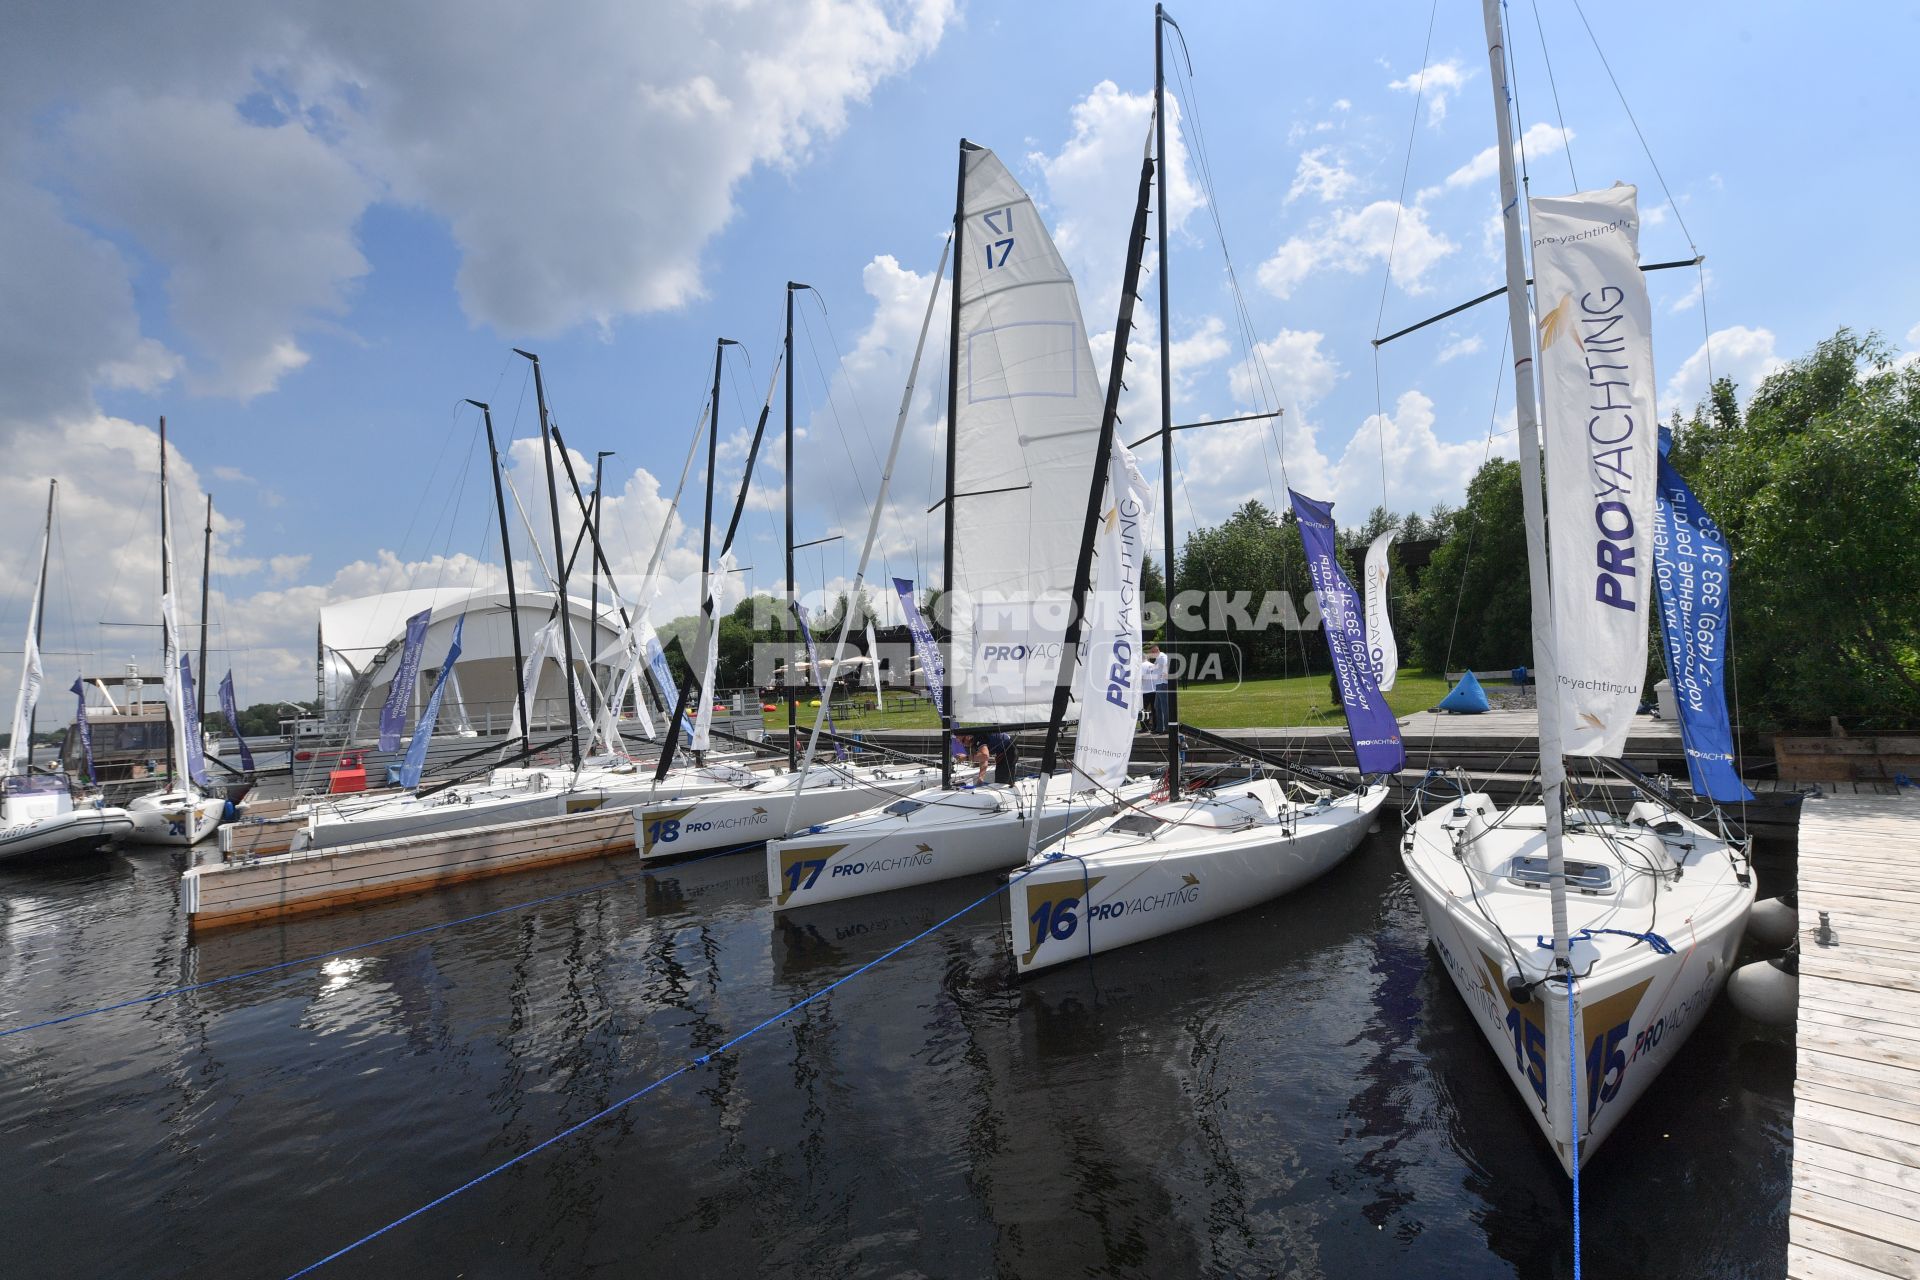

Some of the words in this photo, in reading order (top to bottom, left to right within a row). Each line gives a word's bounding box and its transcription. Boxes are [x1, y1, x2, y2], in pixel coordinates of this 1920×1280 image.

[986, 237, 1015, 270] 17
[1580, 285, 1637, 612] PROYACHTING
[1669, 488, 1698, 557] регаты
[1319, 554, 1341, 604] регаты
[1701, 545, 1723, 567] 31
[1106, 498, 1141, 710] PROYACHTING
[1341, 593, 1355, 608] 31
[1702, 570, 1723, 609] 393
[1345, 611, 1361, 637] 393
[1678, 561, 1704, 712] корпоративные
[1697, 612, 1721, 662] (499)
[1338, 657, 1357, 707] Прокат
[1557, 674, 1638, 696] ro-yachting.ru
[1699, 663, 1713, 688] +7
[647, 820, 681, 843] 18
[685, 813, 769, 834] PROYACHTING
[784, 858, 827, 892] 17
[832, 853, 933, 878] PROYACHTING
[1030, 897, 1081, 945] 16
[1088, 886, 1200, 922] PROYACHTING
[1436, 935, 1503, 1030] PROYACHTING
[1505, 1007, 1547, 1101] 15
[1585, 1019, 1631, 1118] 15
[1631, 976, 1715, 1063] PROYACHTING
